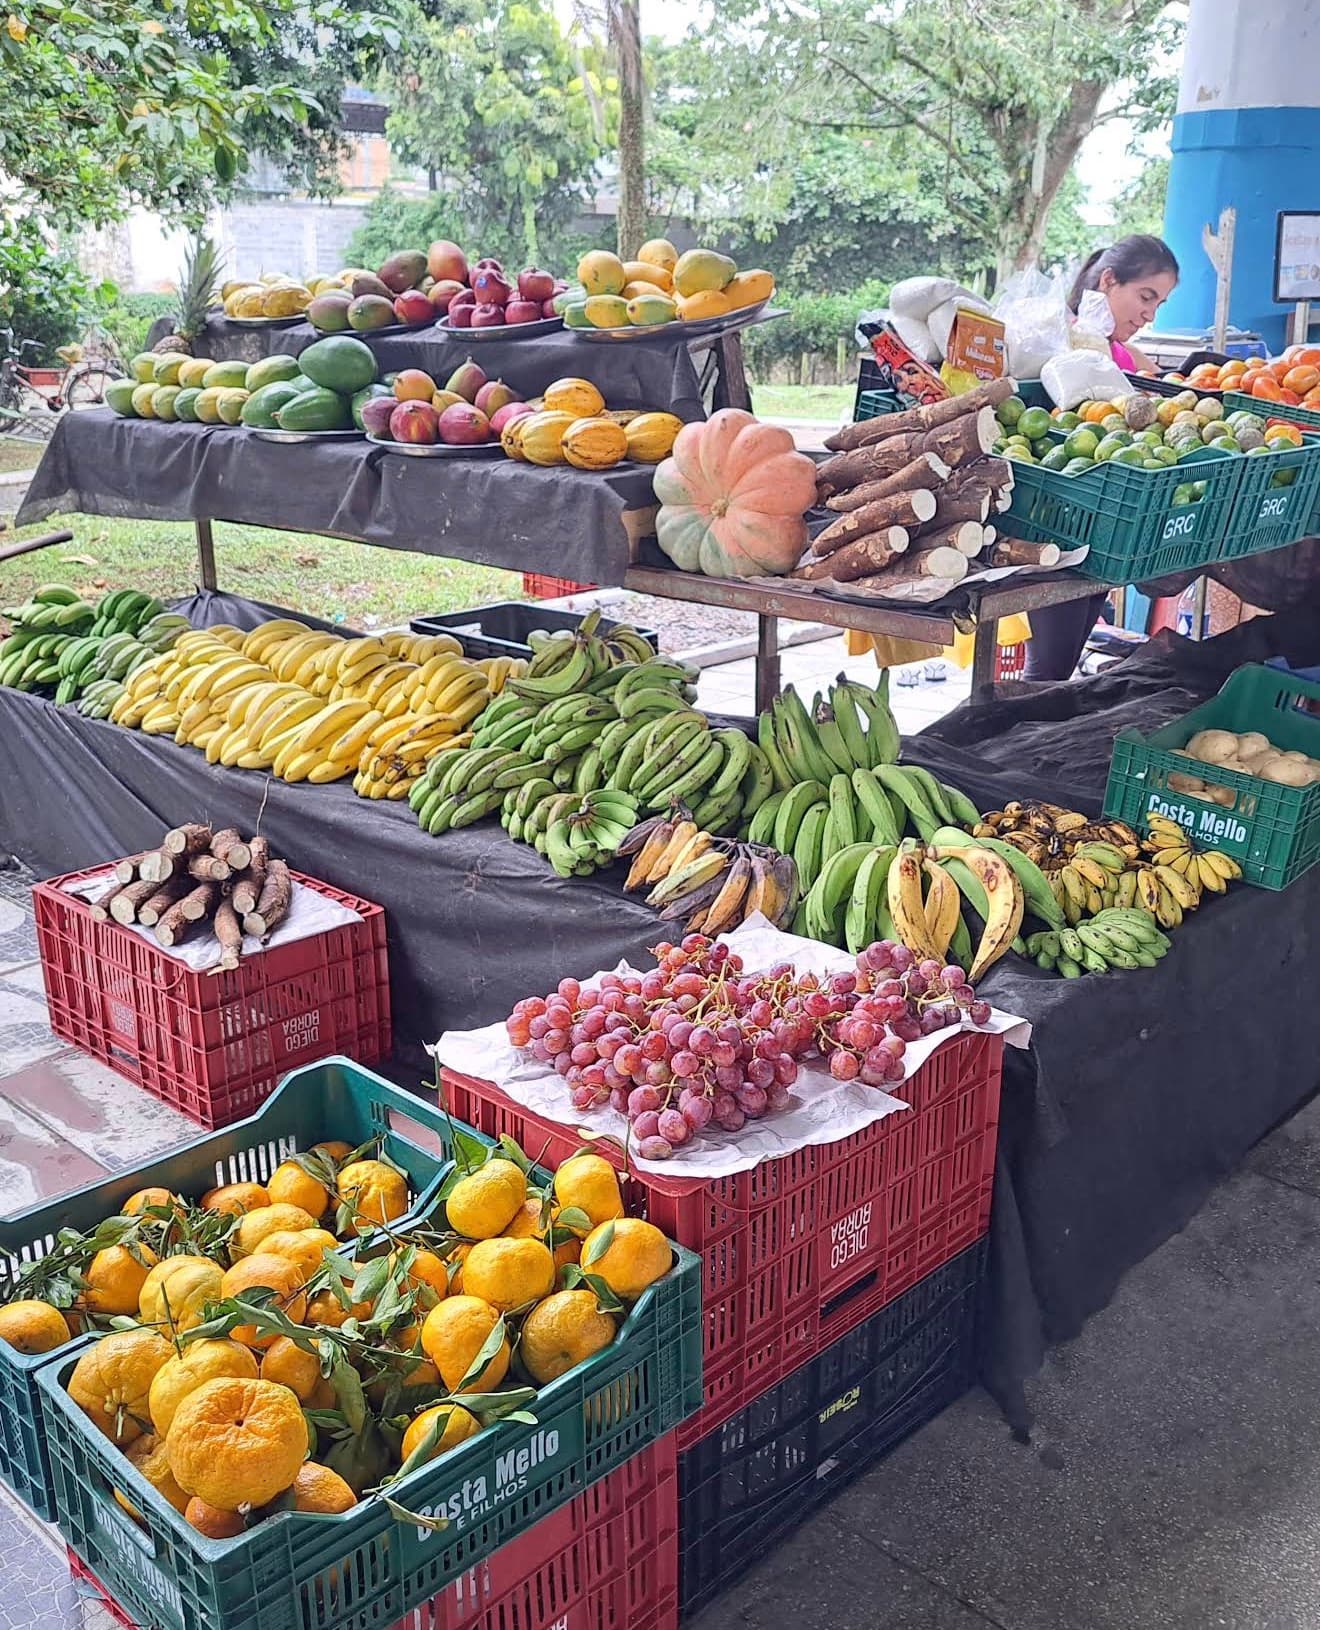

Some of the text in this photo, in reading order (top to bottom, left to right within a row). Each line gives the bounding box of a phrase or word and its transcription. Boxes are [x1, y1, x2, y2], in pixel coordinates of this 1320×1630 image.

[1162, 513, 1195, 539] GRC
[1258, 497, 1287, 517] GRC
[1148, 794, 1247, 842] Costa Mello
[281, 1009, 320, 1036] BORBA
[285, 1026, 319, 1052] DIEGO
[831, 1200, 873, 1244] BORBA
[830, 1225, 869, 1269] DIEGO
[417, 1429, 559, 1542] Costa Mello
[456, 1475, 528, 1531] E FILHOS
